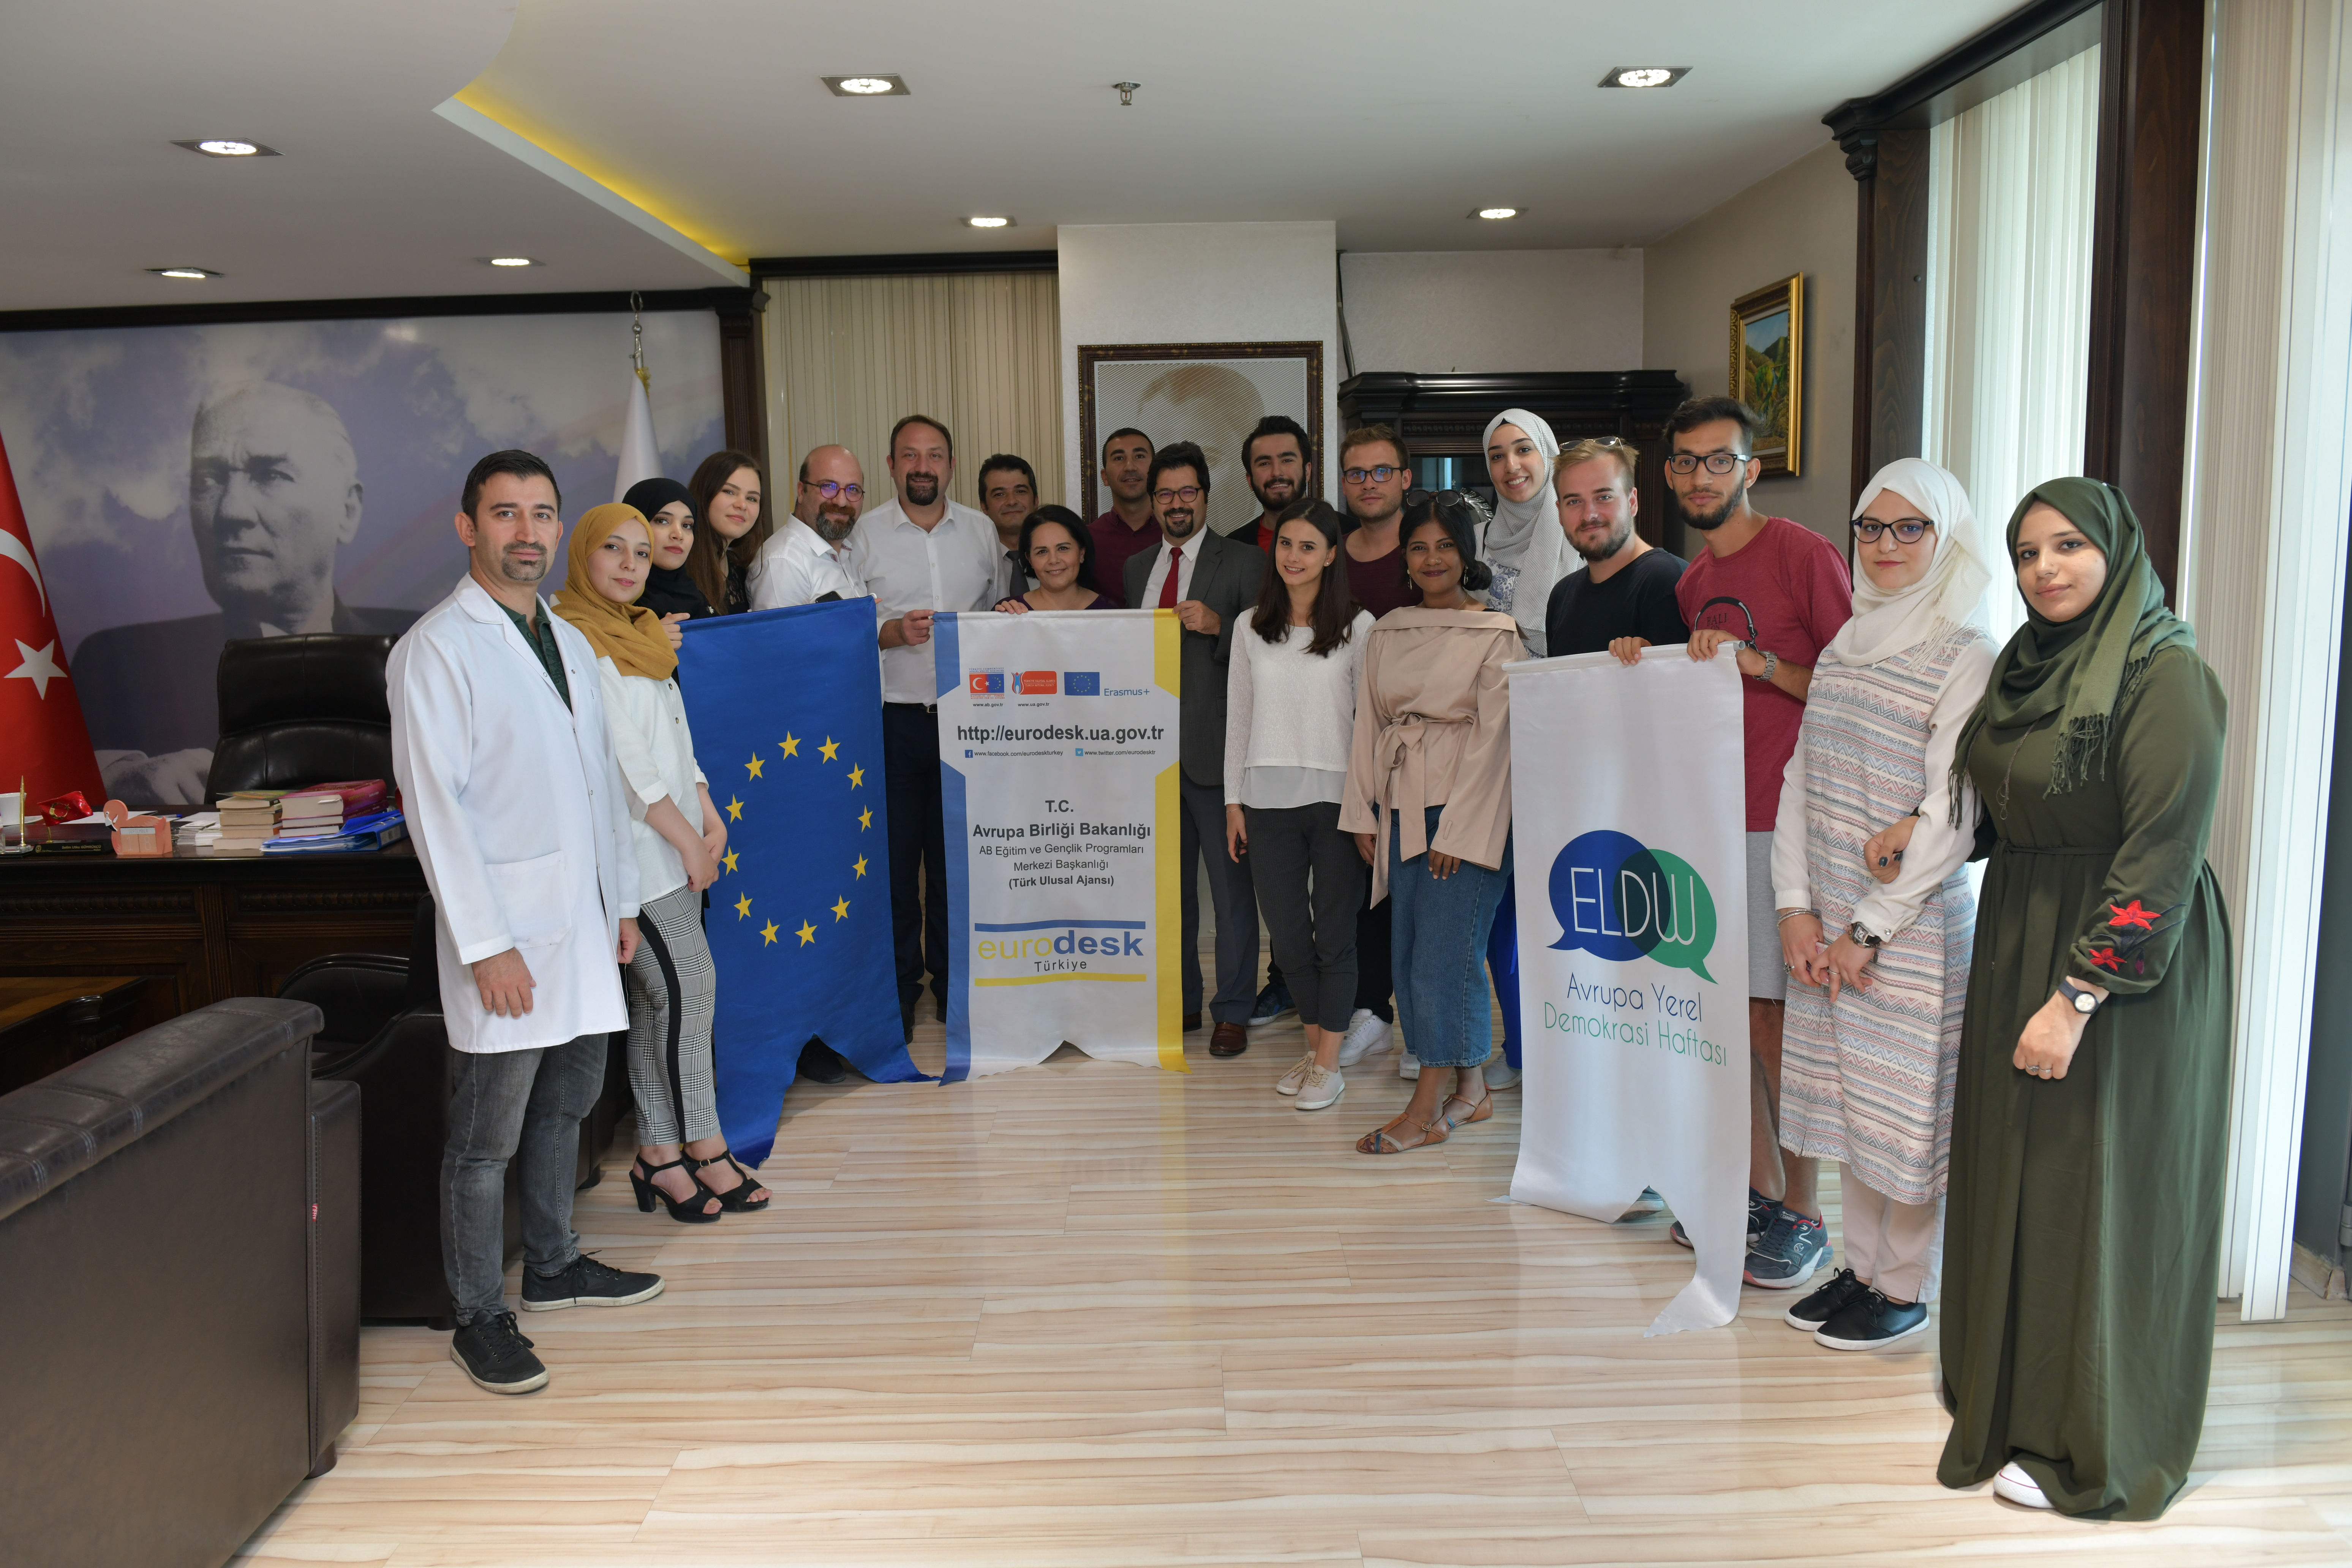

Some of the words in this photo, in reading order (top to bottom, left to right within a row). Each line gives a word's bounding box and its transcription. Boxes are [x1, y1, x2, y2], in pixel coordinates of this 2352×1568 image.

[958, 725, 1164, 744] http://eurodesk.ua.gov.tr
[1045, 800, 1073, 812] T.C.
[973, 824, 1024, 841] Avrupa
[1030, 823, 1075, 839] Birliği
[1080, 823, 1150, 839] Bakanlığı
[980, 846, 993, 855] AB
[996, 846, 1026, 857] Eğitim
[1045, 844, 1083, 855] Gençlik
[1086, 843, 1143, 855] Programları
[1014, 860, 1052, 871] Merkezi
[1056, 859, 1108, 870] Başkanlığı
[1009, 877, 1037, 890] (Türk
[1040, 875, 1073, 885] Ulusal
[1076, 875, 1114, 887] Ajansı)
[1571, 867, 1696, 945] ELDW
[978, 930, 1144, 959] eurodesk
[1034, 959, 1087, 972] Türkiye
[1567, 972, 1643, 1012] Avrupa
[1651, 983, 1702, 1022] Yerel
[1544, 1001, 1649, 1046] Demokrasi
[1658, 1019, 1726, 1066] Haftası
